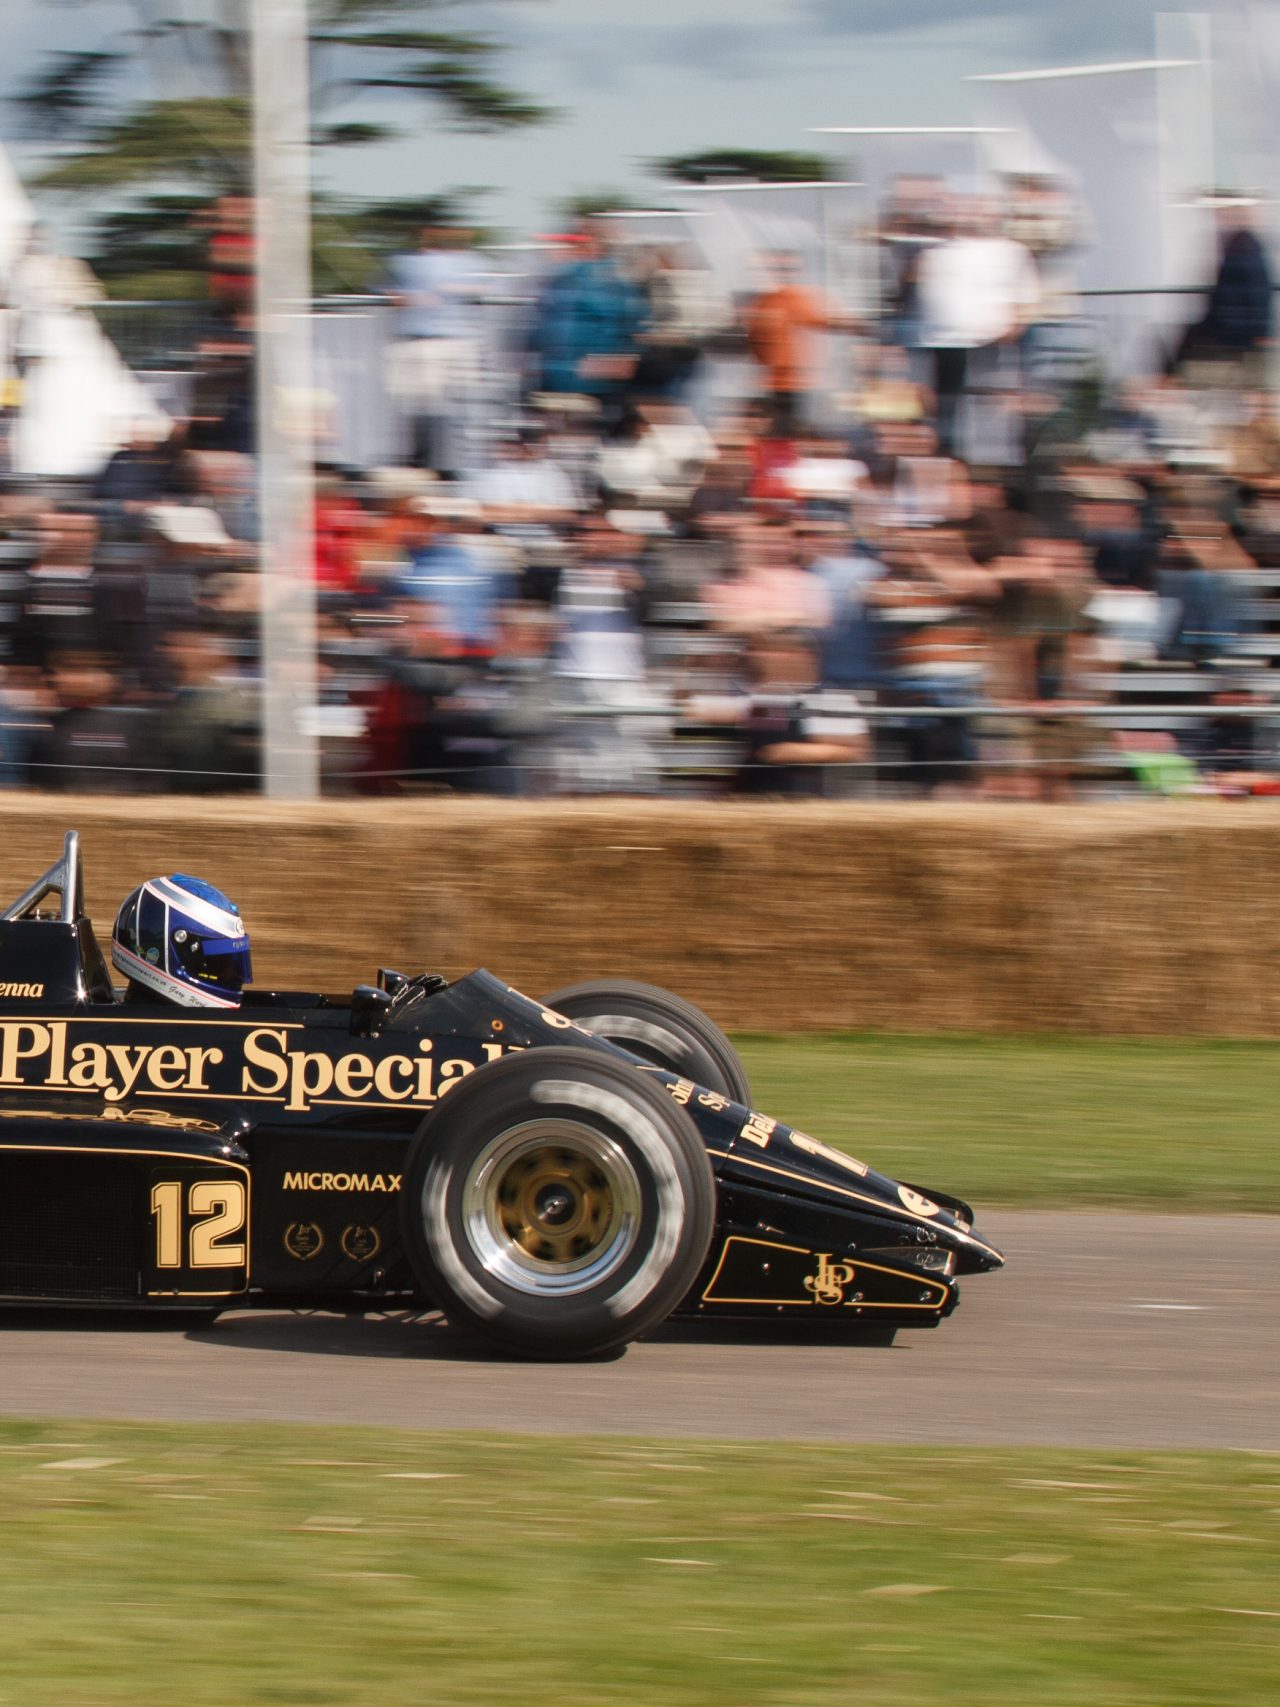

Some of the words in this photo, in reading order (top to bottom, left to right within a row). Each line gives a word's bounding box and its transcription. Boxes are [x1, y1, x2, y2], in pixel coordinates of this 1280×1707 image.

[241, 1028, 503, 1112] Specia
[282, 1171, 403, 1192] MICROMAX
[151, 1180, 245, 1268] 12
